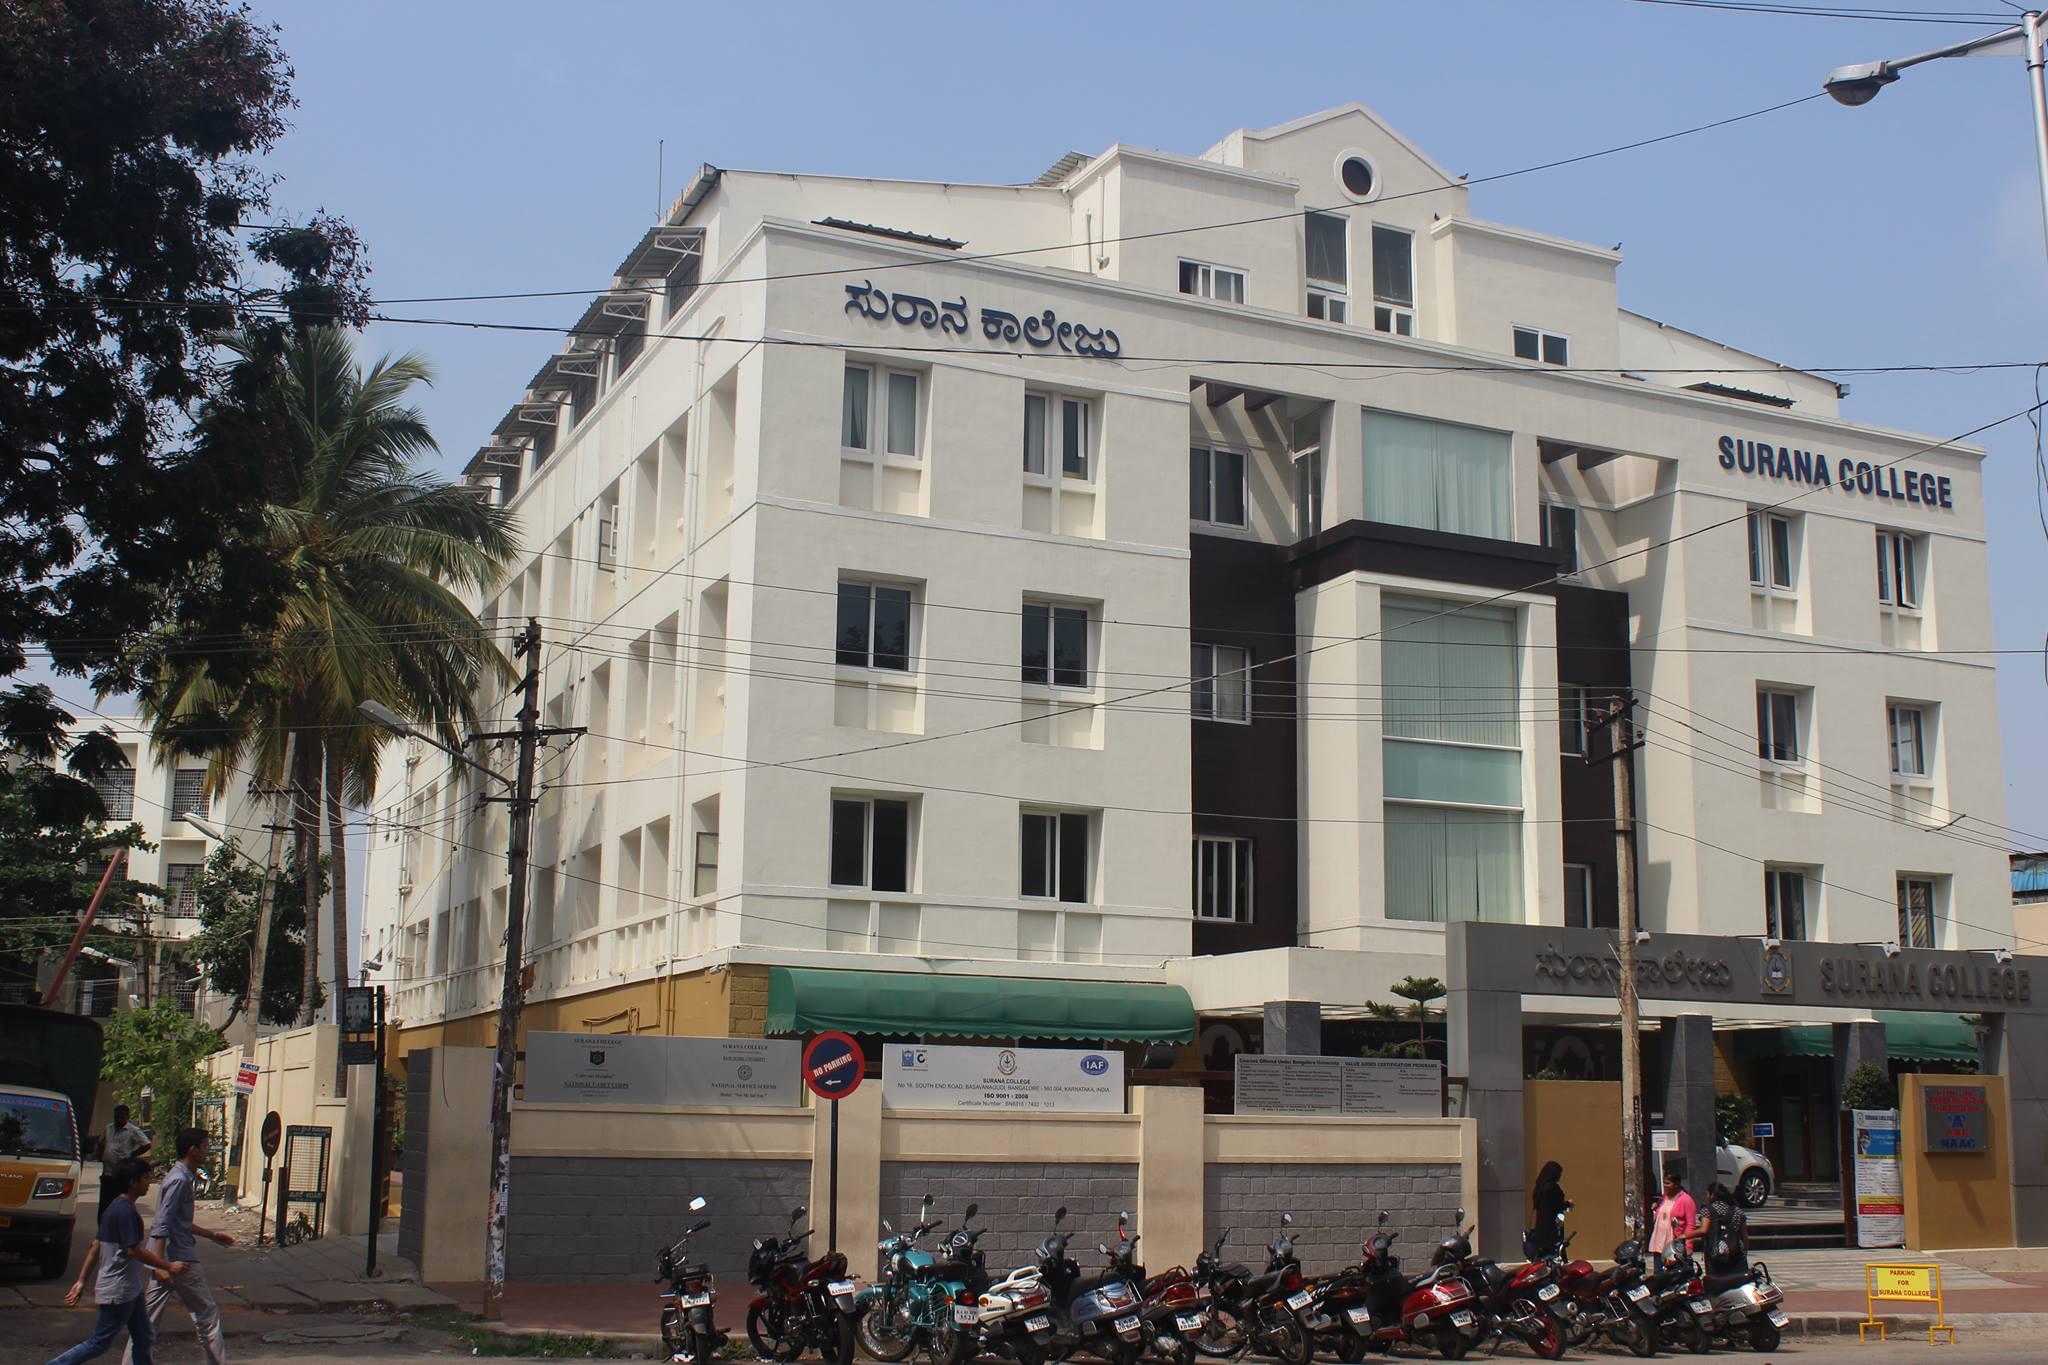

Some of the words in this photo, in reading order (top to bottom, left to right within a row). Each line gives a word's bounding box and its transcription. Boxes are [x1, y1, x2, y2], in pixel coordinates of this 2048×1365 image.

[845, 279, 970, 335] ಸುರಾನ
[980, 309, 1121, 358] ಕಾಲೇಜು
[1718, 435, 1831, 486] SURANA
[1839, 458, 1953, 509] COLLEGE
[1820, 957, 1922, 996] SURANA
[1927, 962, 2030, 1001] COLLEGE
[813, 1066, 823, 1077] NO
[823, 1053, 853, 1072] PARKING
[1086, 1060, 1104, 1069] IAF
[1940, 1137, 1976, 1149] NAAC
